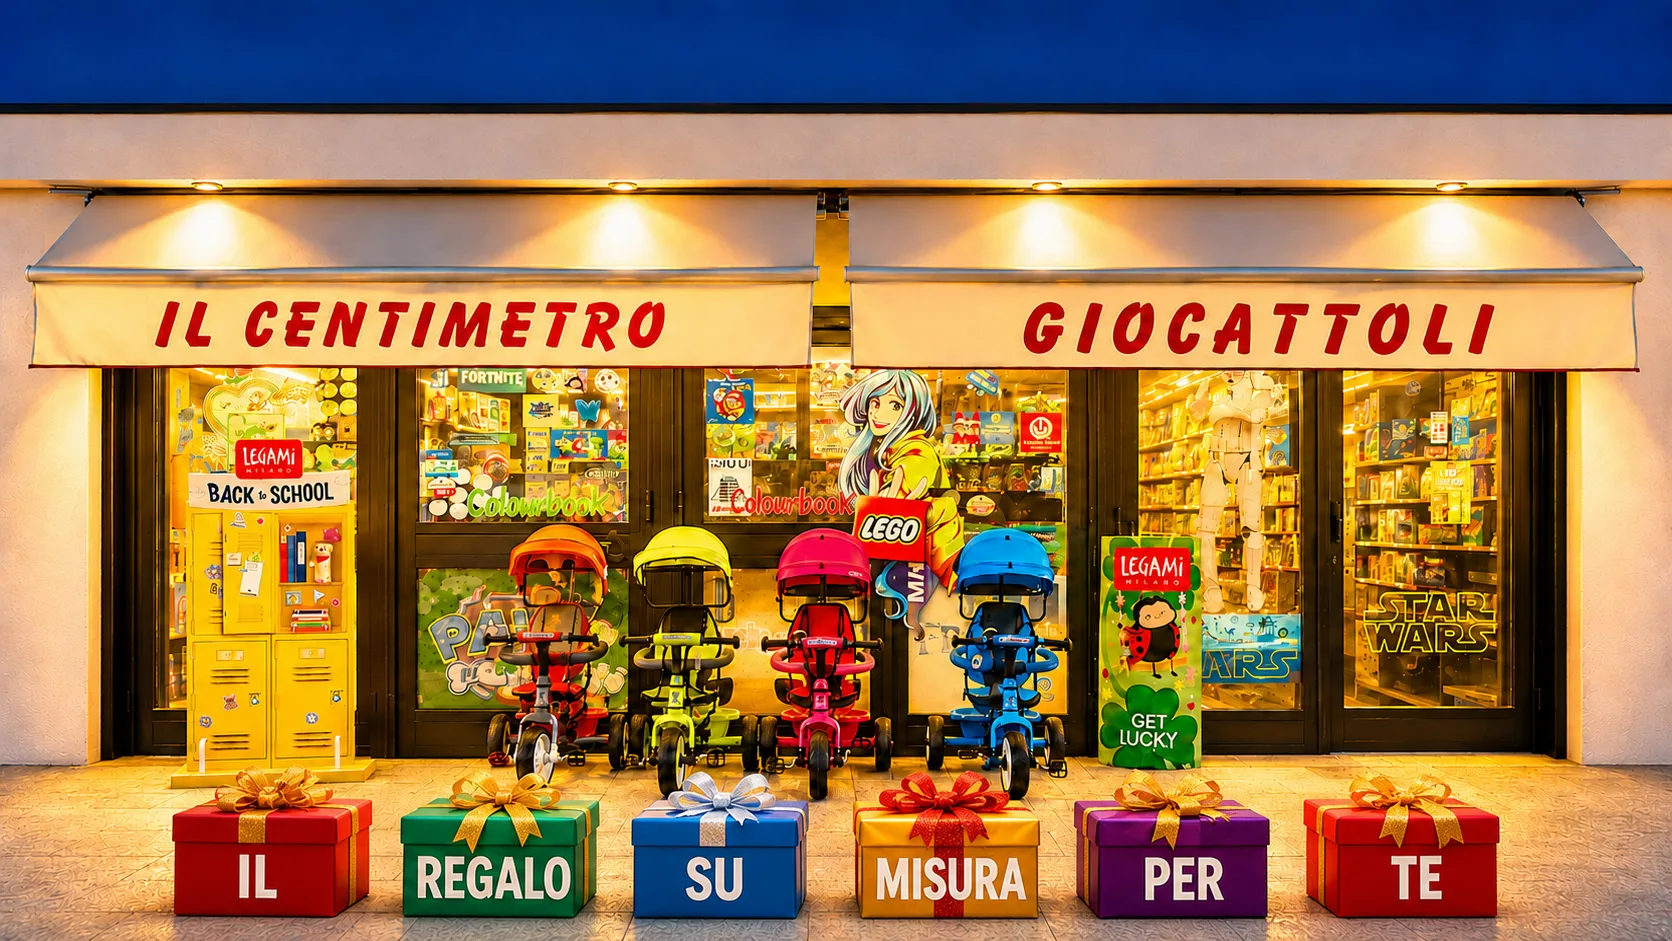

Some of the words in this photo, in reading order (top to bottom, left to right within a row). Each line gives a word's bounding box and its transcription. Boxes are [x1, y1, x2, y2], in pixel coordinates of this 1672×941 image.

[154, 301, 212, 348] IL
[244, 301, 665, 352] CENTIMETRO
[1023, 301, 1495, 356] GIOCATTOLI
[461, 370, 523, 386] FORTNITE
[207, 483, 255, 504] BACK
[270, 482, 334, 504] SCHOOL
[859, 515, 921, 543] LEGO
[1363, 591, 1497, 623] STAR
[1364, 622, 1498, 653] WARS
[1202, 648, 1299, 679] ARS
[1119, 729, 1178, 749] LUCKY
[1131, 713, 1168, 730] GET
[239, 854, 277, 899] IL
[417, 855, 571, 900] REGALO
[685, 856, 743, 901] SU
[875, 857, 1027, 901] MISURA
[1144, 857, 1225, 901] PER
[1391, 855, 1442, 900] TE
